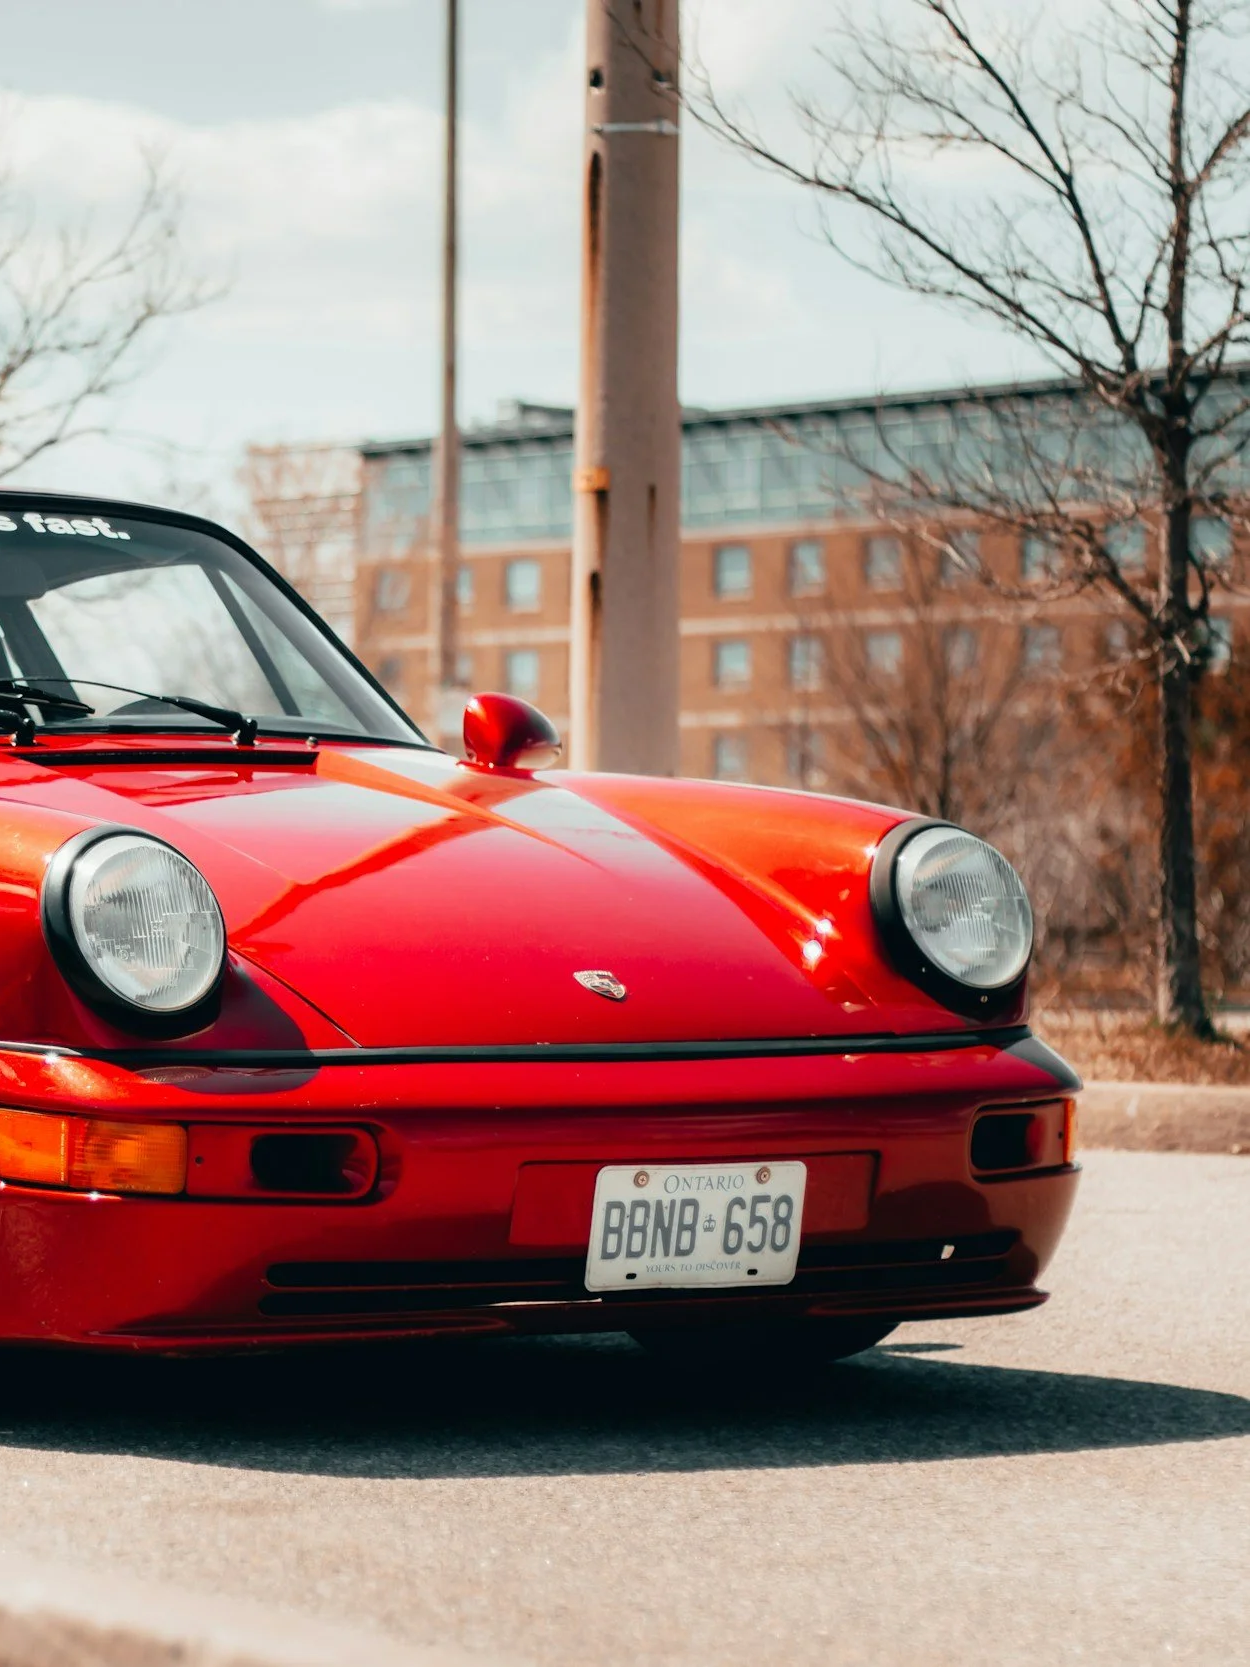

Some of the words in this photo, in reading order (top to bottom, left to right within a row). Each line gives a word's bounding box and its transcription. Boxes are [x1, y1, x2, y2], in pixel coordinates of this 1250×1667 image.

[22, 512, 131, 540] fast.
[663, 1174, 745, 1194] ONTARIO
[600, 1198, 700, 1261] BBNB
[722, 1194, 794, 1256] 658
[646, 1263, 676, 1273] YOURS
[680, 1263, 693, 1272] TO
[695, 1261, 741, 1272] DISCOVER
